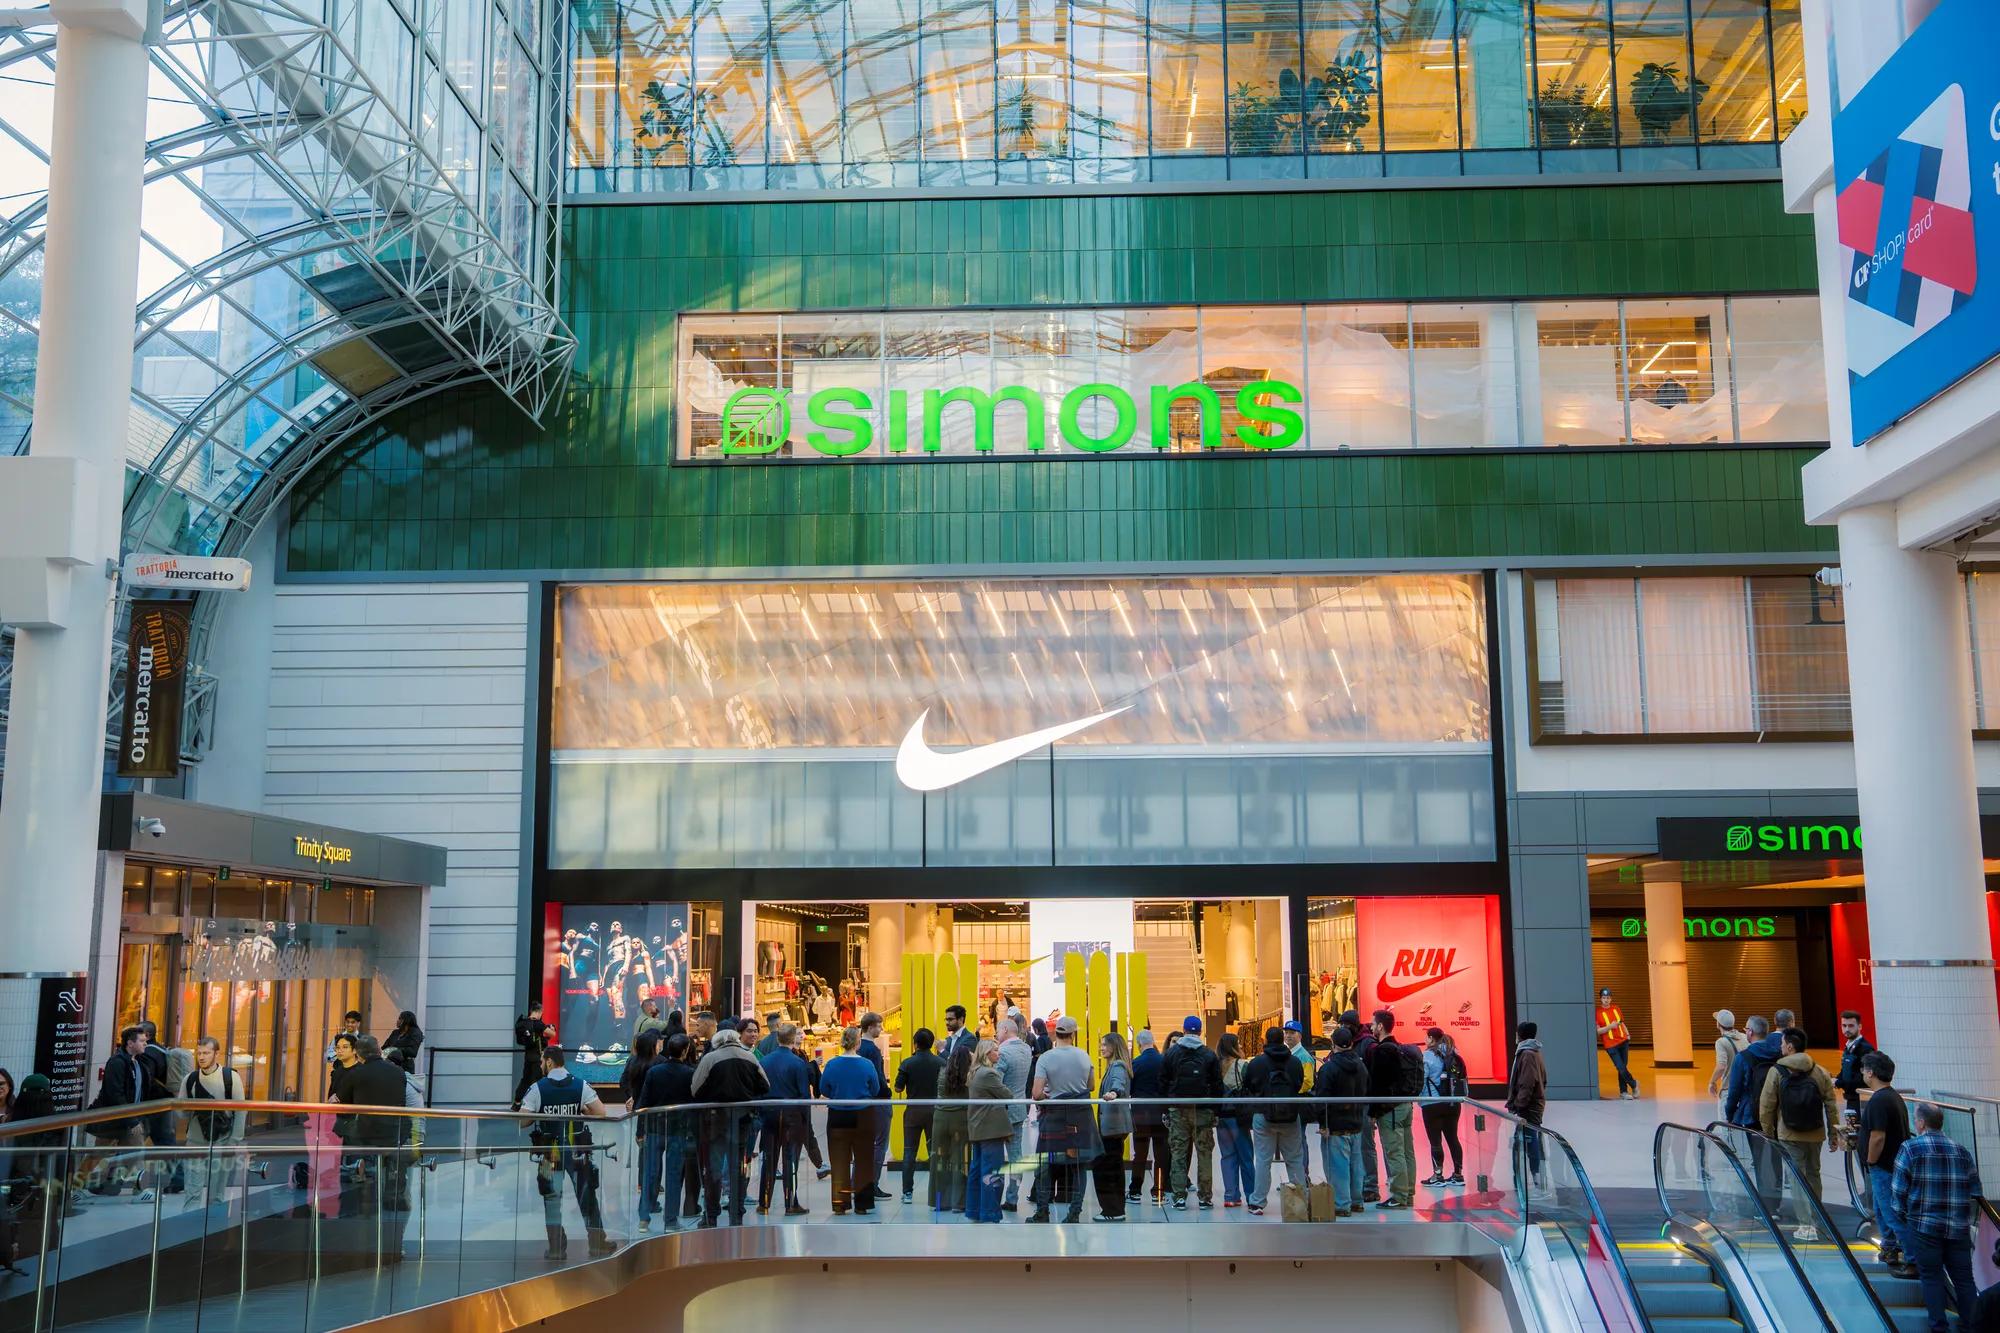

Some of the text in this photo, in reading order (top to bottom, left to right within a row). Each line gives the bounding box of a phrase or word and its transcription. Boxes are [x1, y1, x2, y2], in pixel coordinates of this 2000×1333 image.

[1854, 260, 1871, 288] CF
[1871, 230, 1906, 274] SHOP!
[806, 380, 1304, 455] simons
[136, 559, 178, 576] TRATTORIA
[165, 570, 234, 581] mercatto
[145, 612, 171, 679] TRATTORIA
[131, 646, 154, 763] mercatto
[296, 836, 352, 865] Trinity Square
[1758, 825, 1863, 852] sim
[1644, 917, 1775, 937] mons
[1392, 948, 1457, 977] RUN
[543, 1102, 579, 1116] SECURITY
